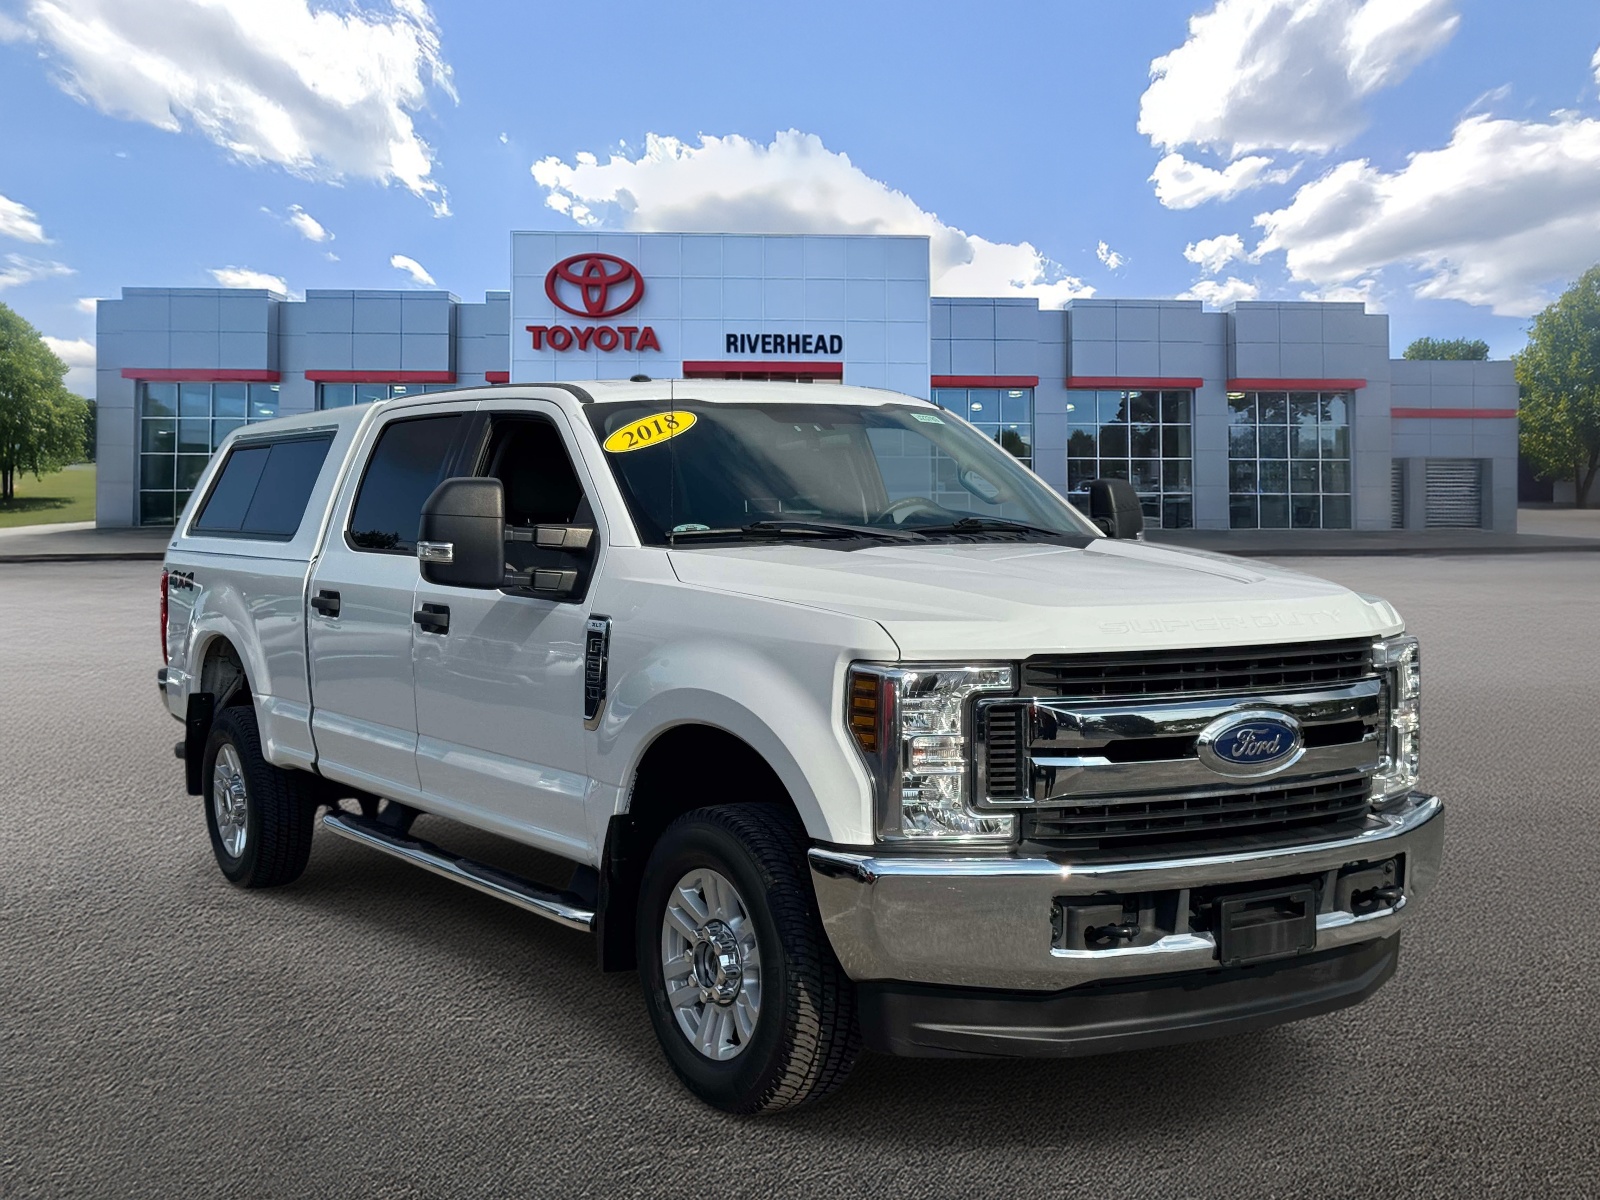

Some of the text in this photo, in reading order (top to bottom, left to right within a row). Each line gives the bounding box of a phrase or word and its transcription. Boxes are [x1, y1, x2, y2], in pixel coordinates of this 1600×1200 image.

[525, 325, 661, 352] TOYOTA
[726, 333, 843, 354] RIVERHEAD
[621, 414, 680, 448] 2018
[1099, 609, 1341, 635] SUPER DUTY
[1231, 728, 1282, 757] Ford
